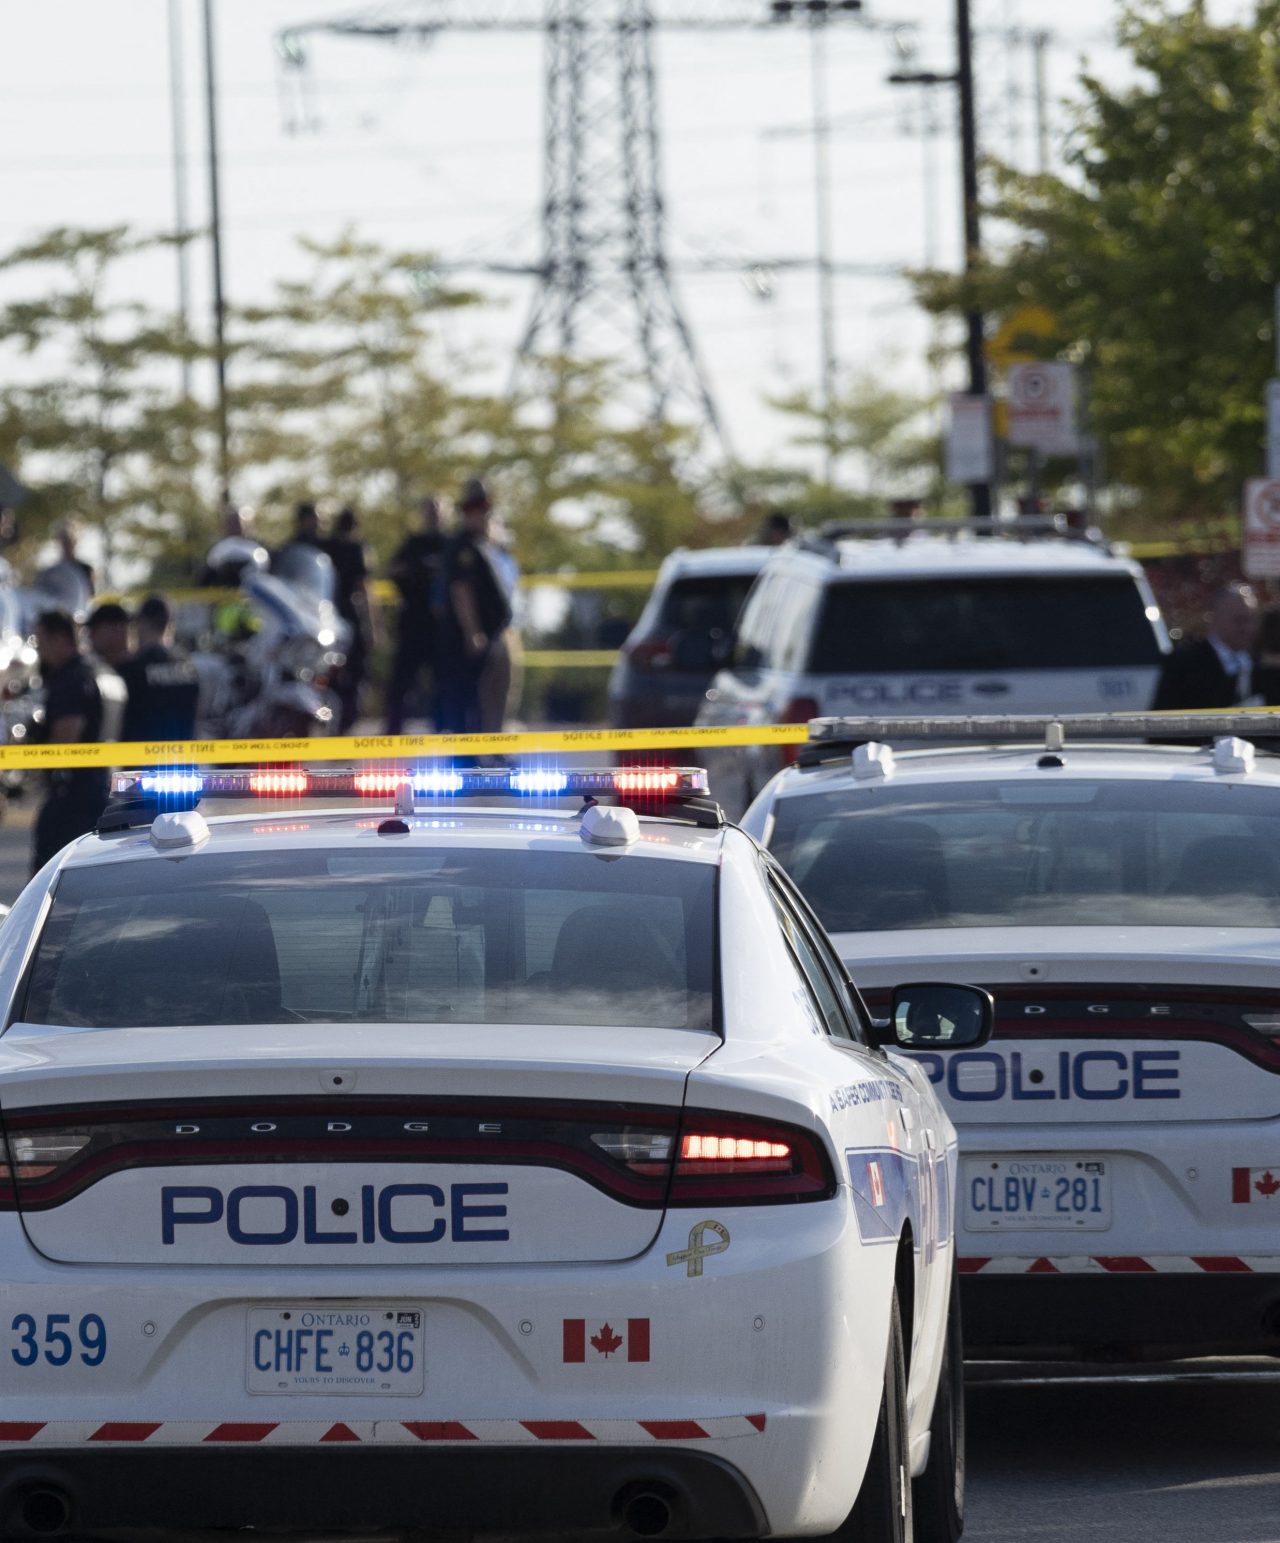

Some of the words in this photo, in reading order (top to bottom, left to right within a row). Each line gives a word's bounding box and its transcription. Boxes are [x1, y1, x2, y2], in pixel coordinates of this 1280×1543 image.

[826, 678, 961, 705] POLICE
[1024, 1004, 1171, 1015] DGE
[176, 1122, 502, 1135] DODGE
[1009, 1163, 1067, 1176] ONTARIO
[971, 1177, 1037, 1213] CLBV
[1055, 1177, 1102, 1213] 281
[161, 1182, 510, 1245] POLICE
[301, 1313, 370, 1328] ONTARIO
[11, 1313, 107, 1366] 359
[254, 1329, 334, 1372] CHFE
[356, 1330, 414, 1373] 836
